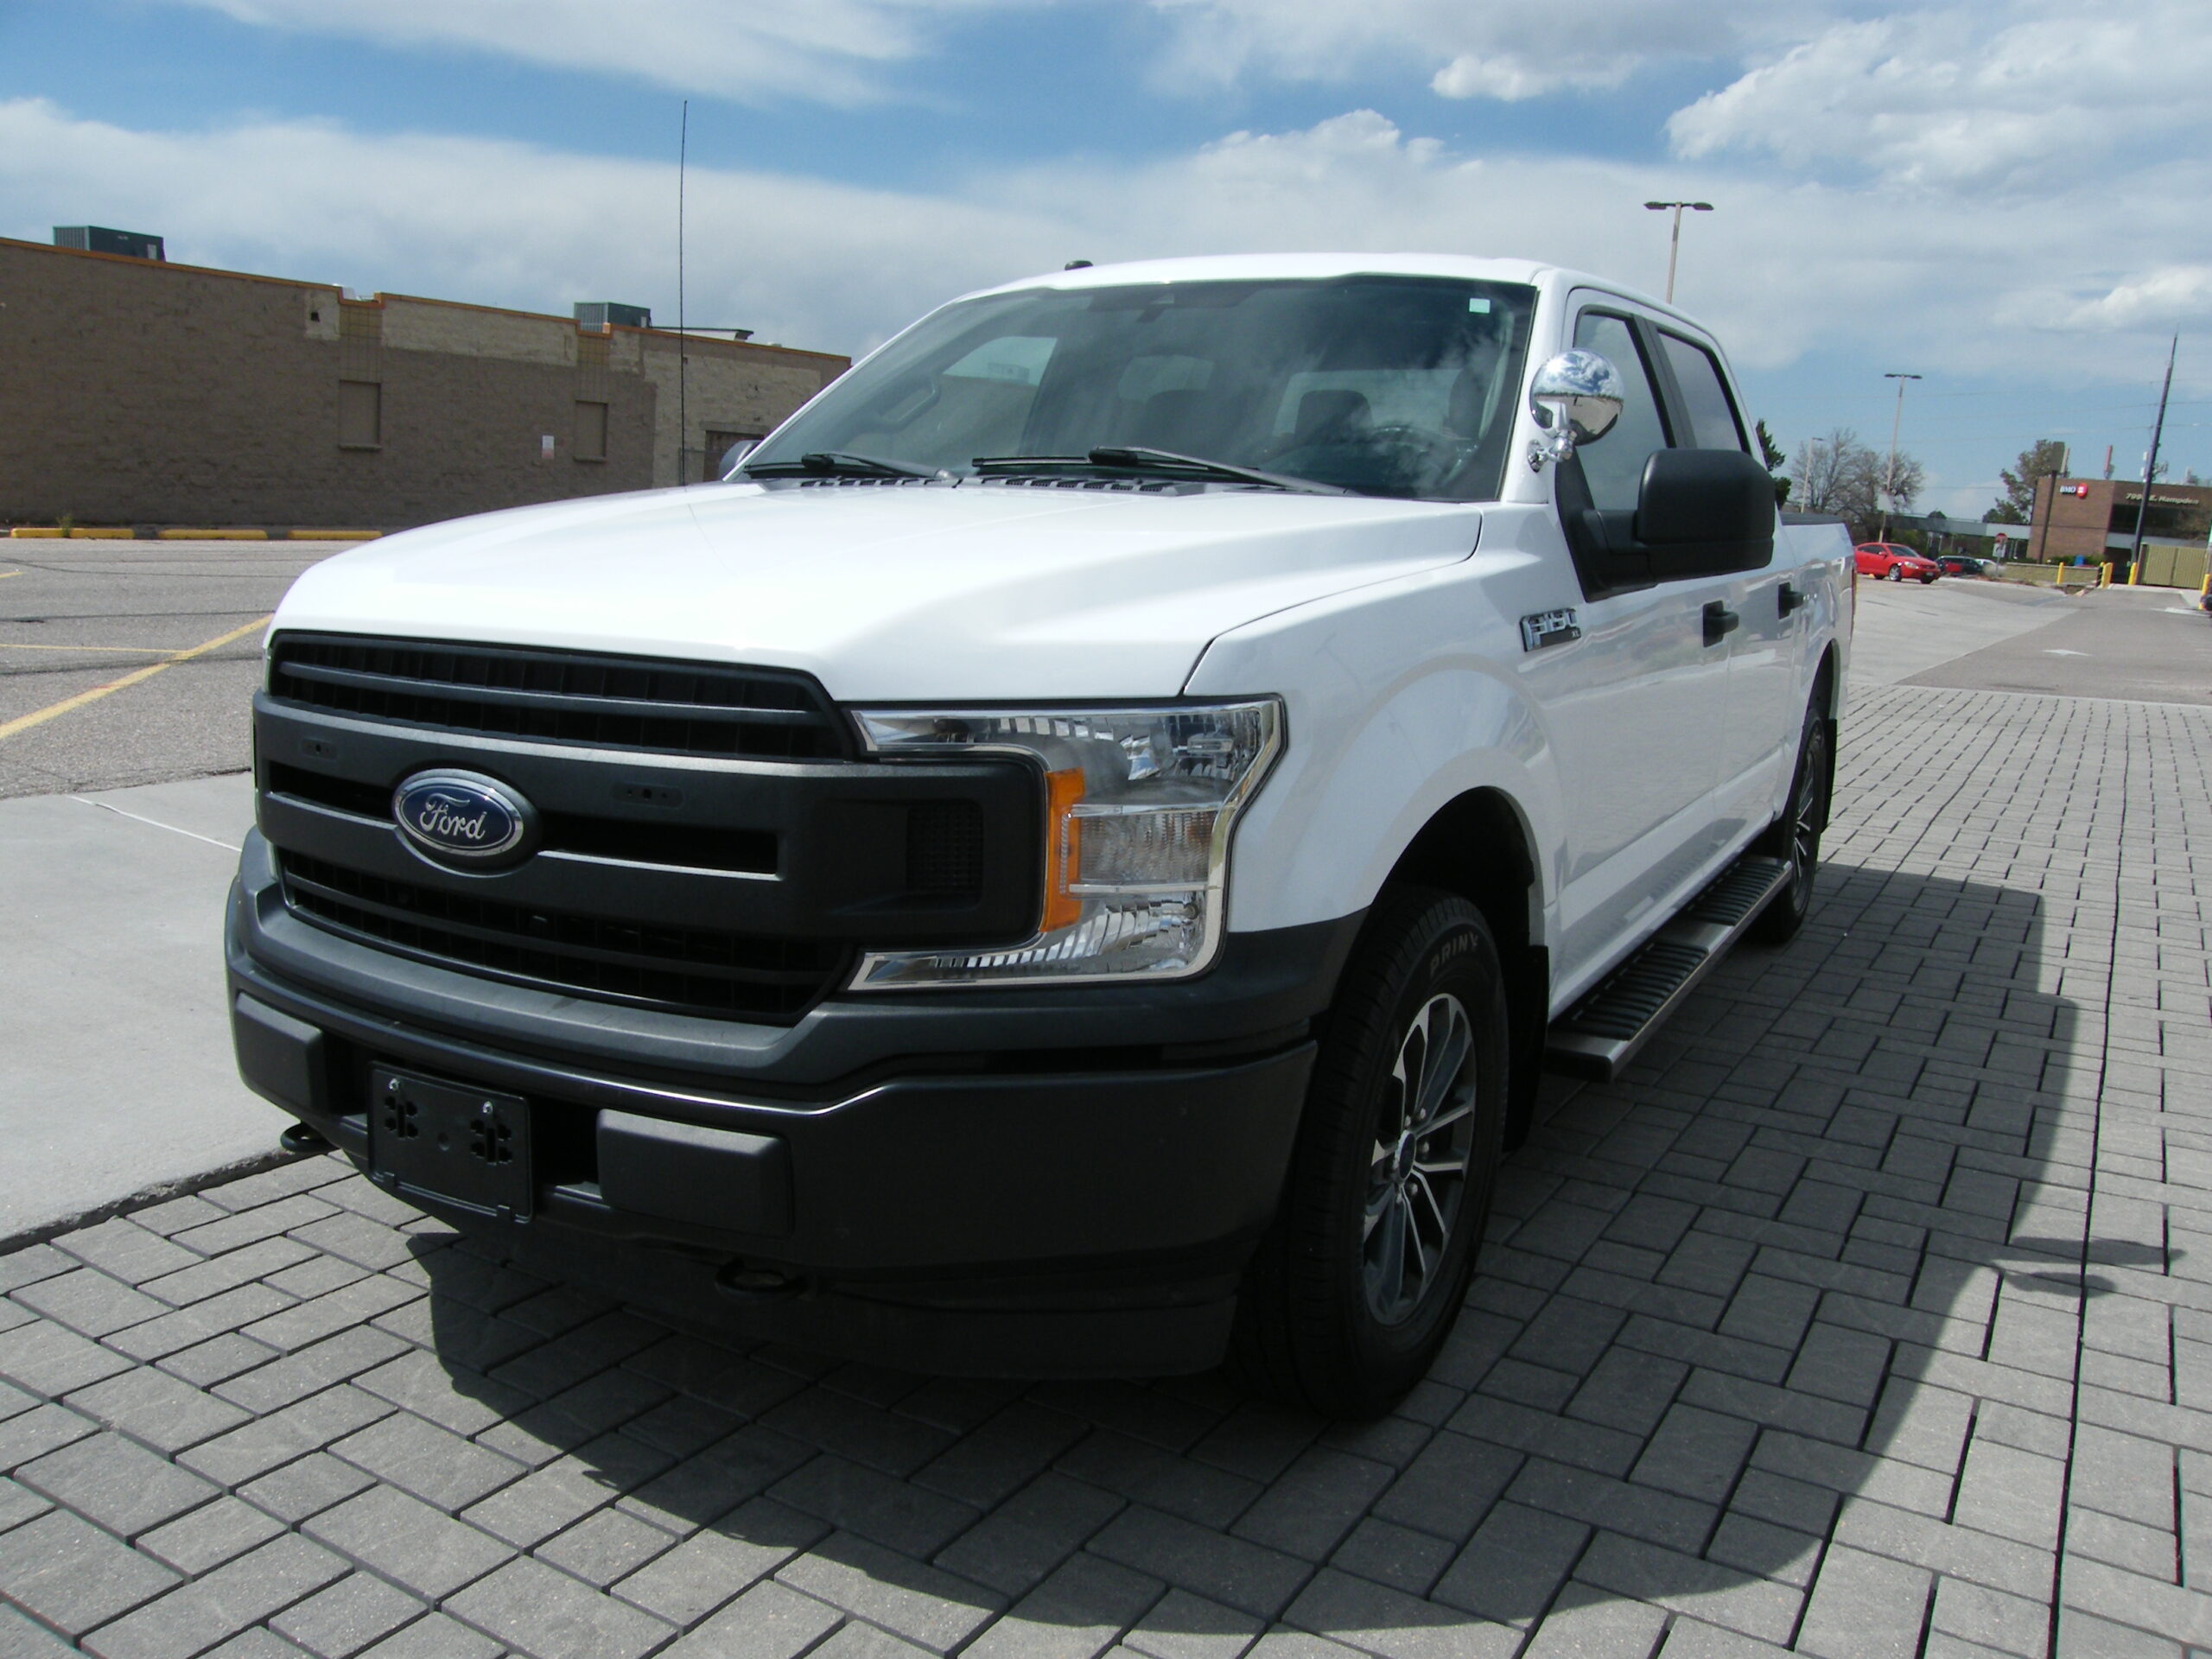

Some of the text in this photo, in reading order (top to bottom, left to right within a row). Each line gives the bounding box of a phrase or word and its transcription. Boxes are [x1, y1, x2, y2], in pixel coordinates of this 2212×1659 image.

[2060, 485, 2076, 493] BMO
[2158, 496, 2199, 505] Hampden
[420, 793, 486, 840] Ford
